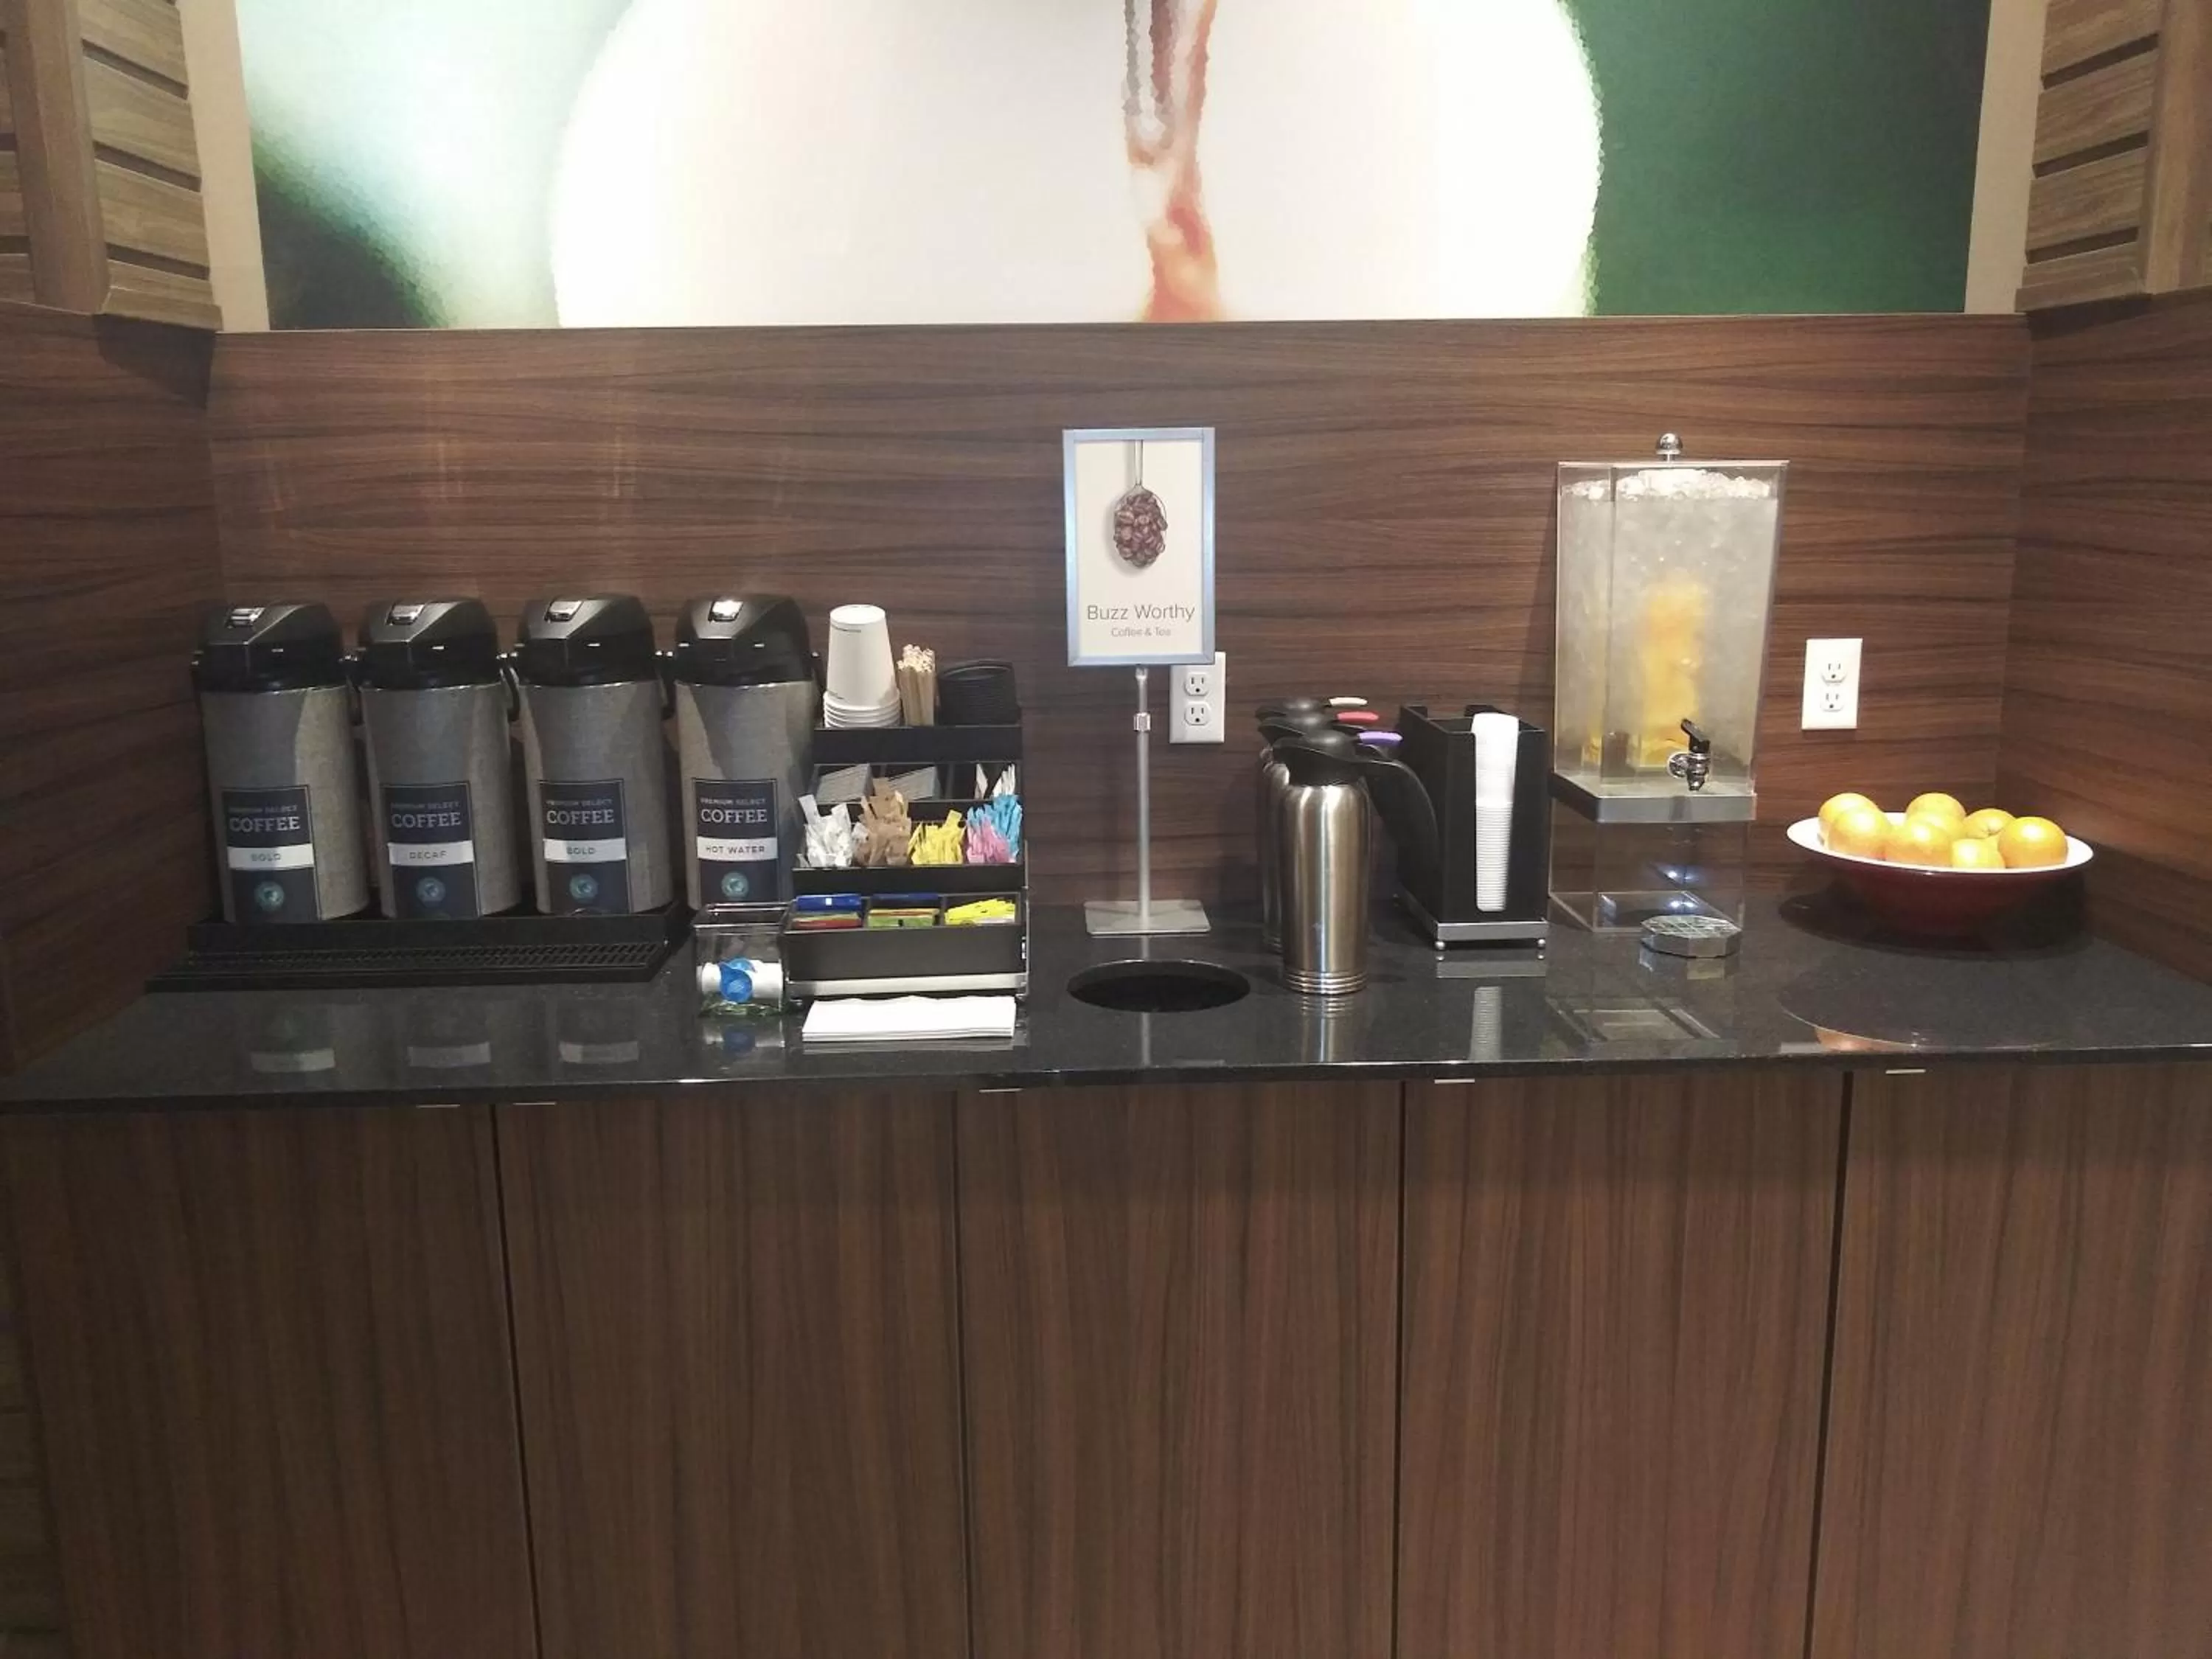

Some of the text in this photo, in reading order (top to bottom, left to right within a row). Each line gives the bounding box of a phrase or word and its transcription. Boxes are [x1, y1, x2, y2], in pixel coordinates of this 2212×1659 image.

[1087, 602, 1195, 622] Buzz Worthy
[1111, 627, 1142, 637] Coffee
[229, 816, 301, 832] COFFEE
[392, 812, 462, 828] COFFEE
[547, 809, 614, 825] COFFEE
[701, 809, 768, 824] COFFEE
[409, 850, 448, 859] DECAF
[566, 846, 597, 855] BOLD
[706, 846, 765, 854] HOT WATER
